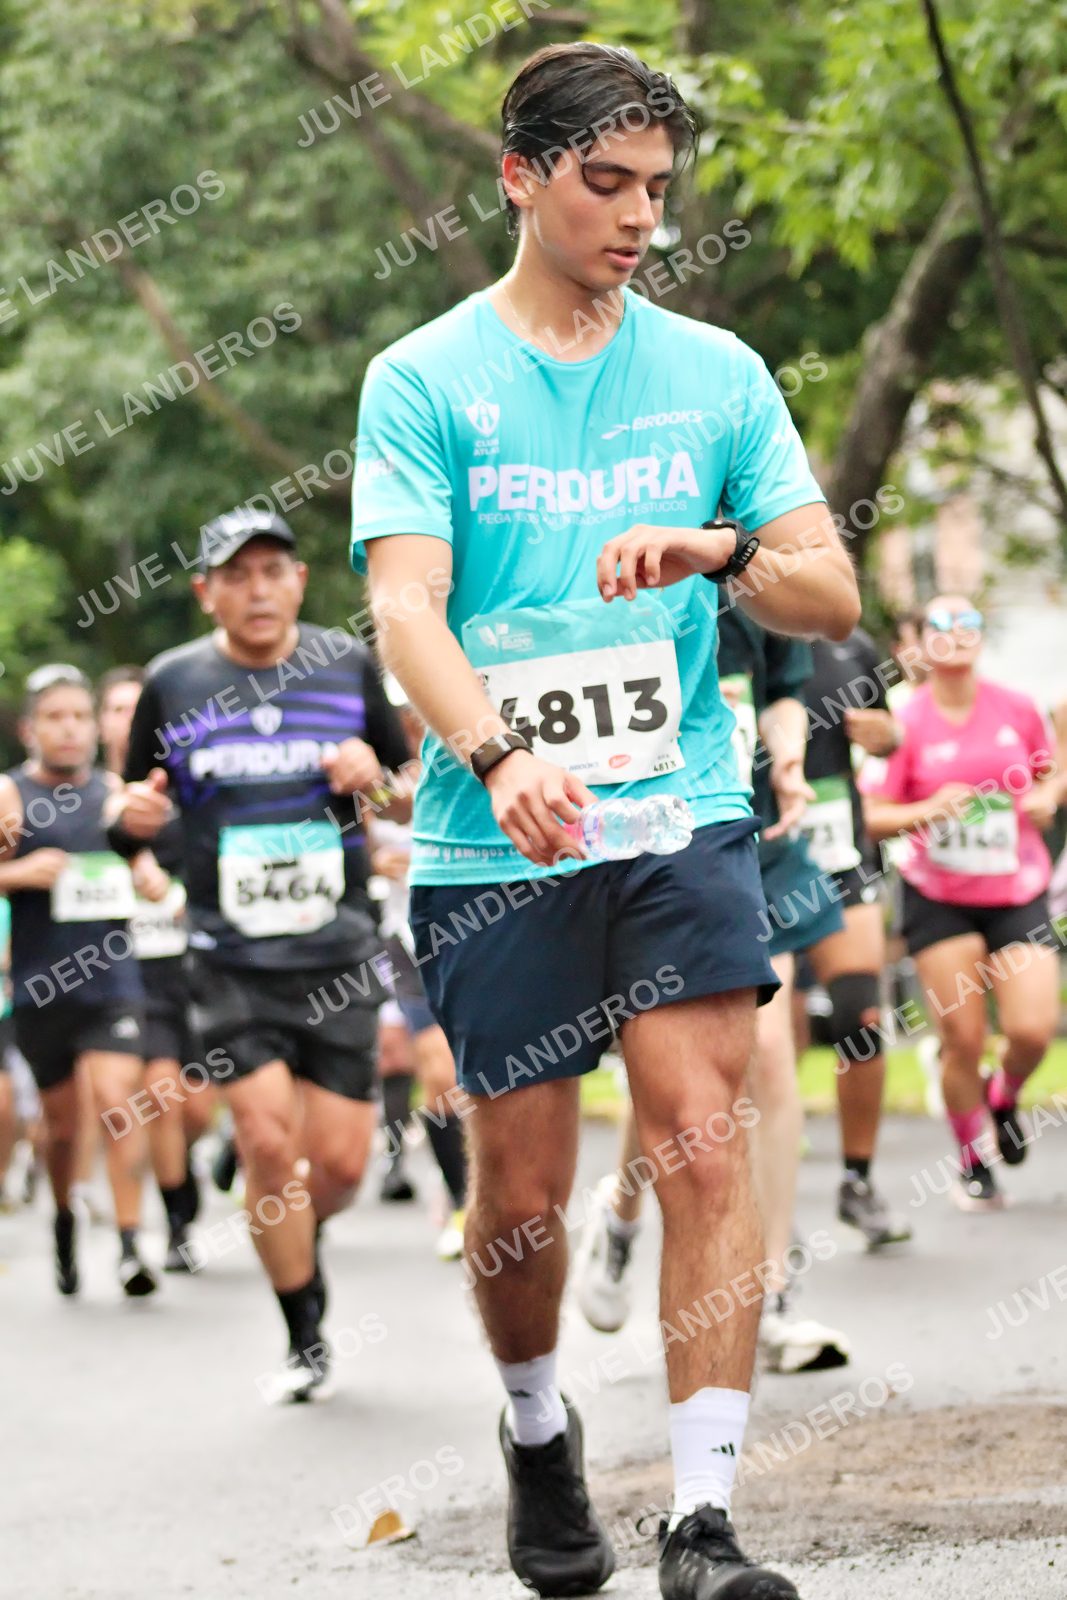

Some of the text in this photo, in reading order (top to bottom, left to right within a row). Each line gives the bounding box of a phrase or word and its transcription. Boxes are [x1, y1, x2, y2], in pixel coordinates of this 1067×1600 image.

[632, 410, 703, 430] BROOKS
[468, 451, 700, 513] PERDURA
[478, 513, 511, 525] PEGA
[633, 501, 688, 516] ESTUCOS
[500, 676, 668, 749] 4813
